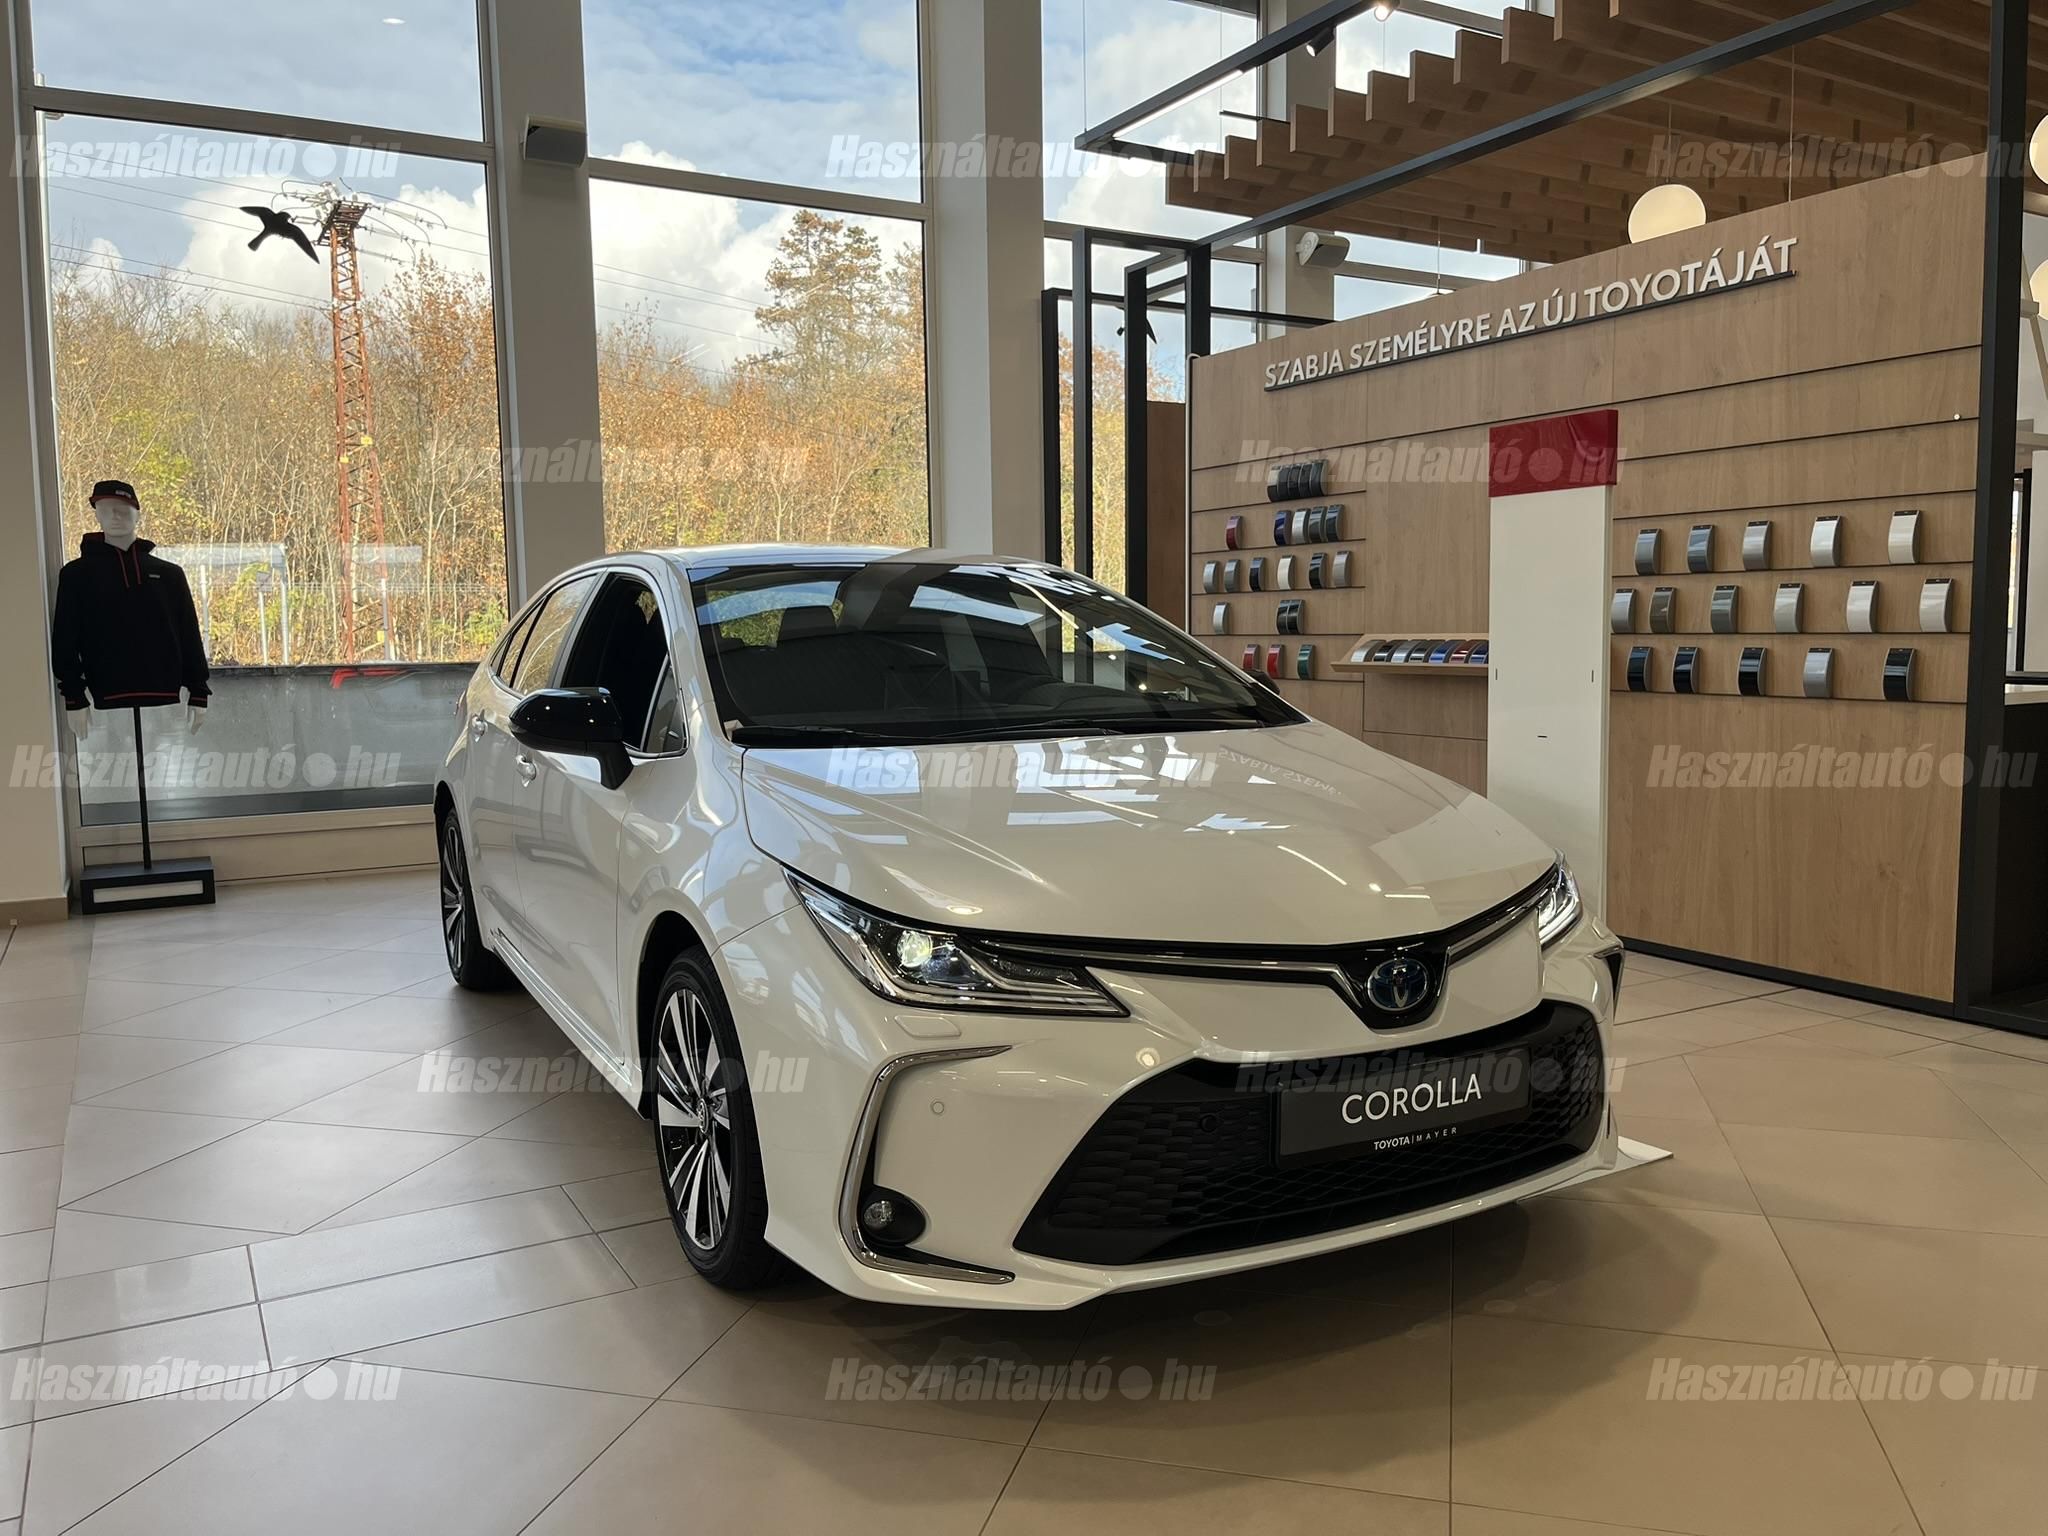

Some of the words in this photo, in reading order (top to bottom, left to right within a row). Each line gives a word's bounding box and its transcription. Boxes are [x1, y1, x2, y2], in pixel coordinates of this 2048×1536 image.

[1265, 348, 1345, 388] SZABJA
[1350, 313, 1491, 370] SZEMÉLYRE
[1496, 302, 1537, 338] AZ
[1542, 288, 1578, 326] ÚJ
[1584, 235, 1798, 317] TOYOTÁJÁT
[1341, 1073, 1482, 1124] COROLLA
[1374, 1135, 1410, 1150] TOYOTA
[1416, 1127, 1457, 1142] MAYER
